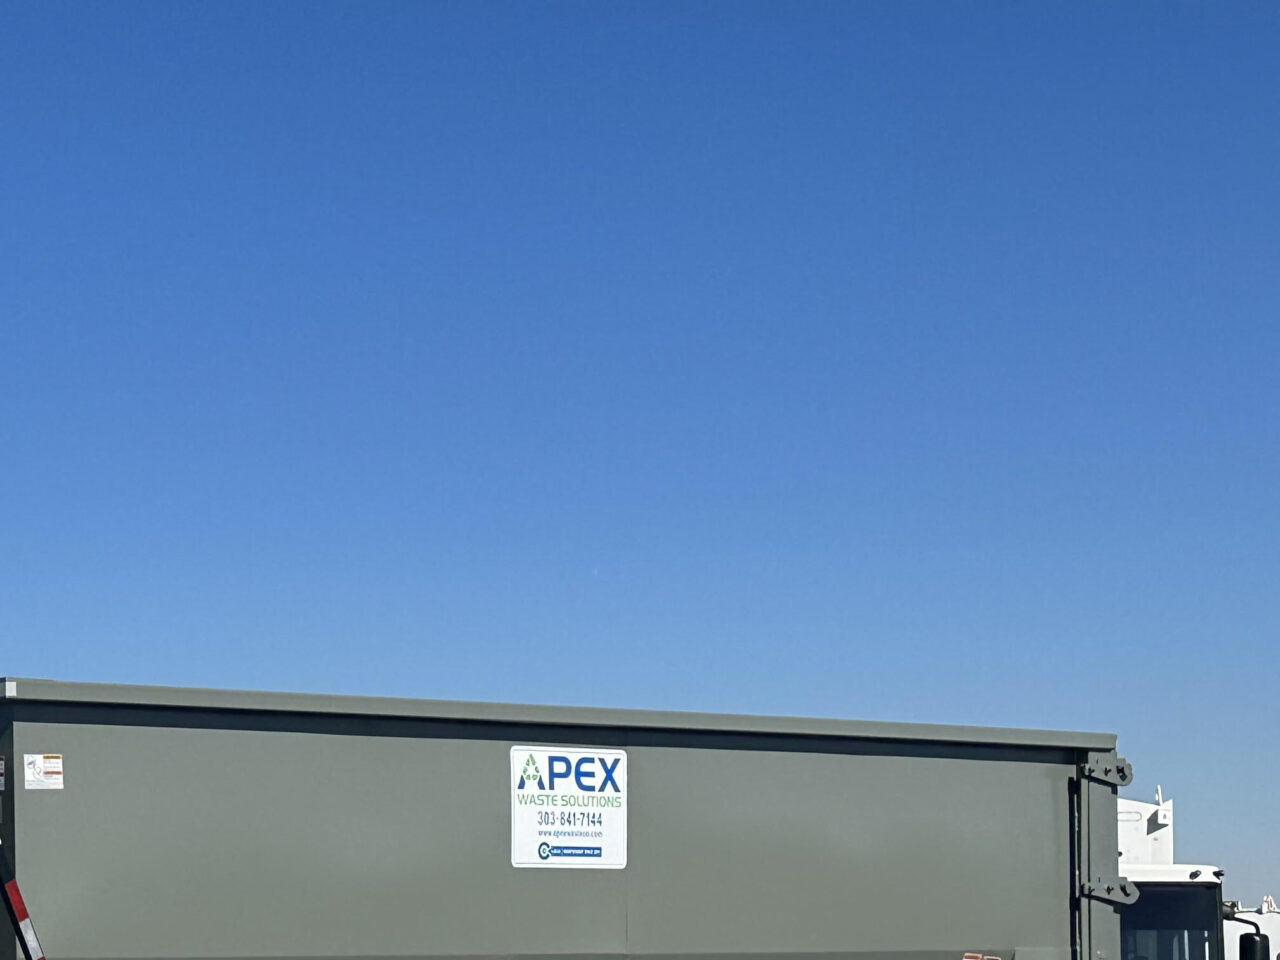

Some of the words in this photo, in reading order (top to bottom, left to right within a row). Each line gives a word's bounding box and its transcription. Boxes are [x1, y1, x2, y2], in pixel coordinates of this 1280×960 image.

[517, 753, 621, 792] APEX
[517, 794, 558, 806] WASTE
[561, 795, 622, 808] SOLUTIONS
[537, 811, 602, 826] 303-841-7144
